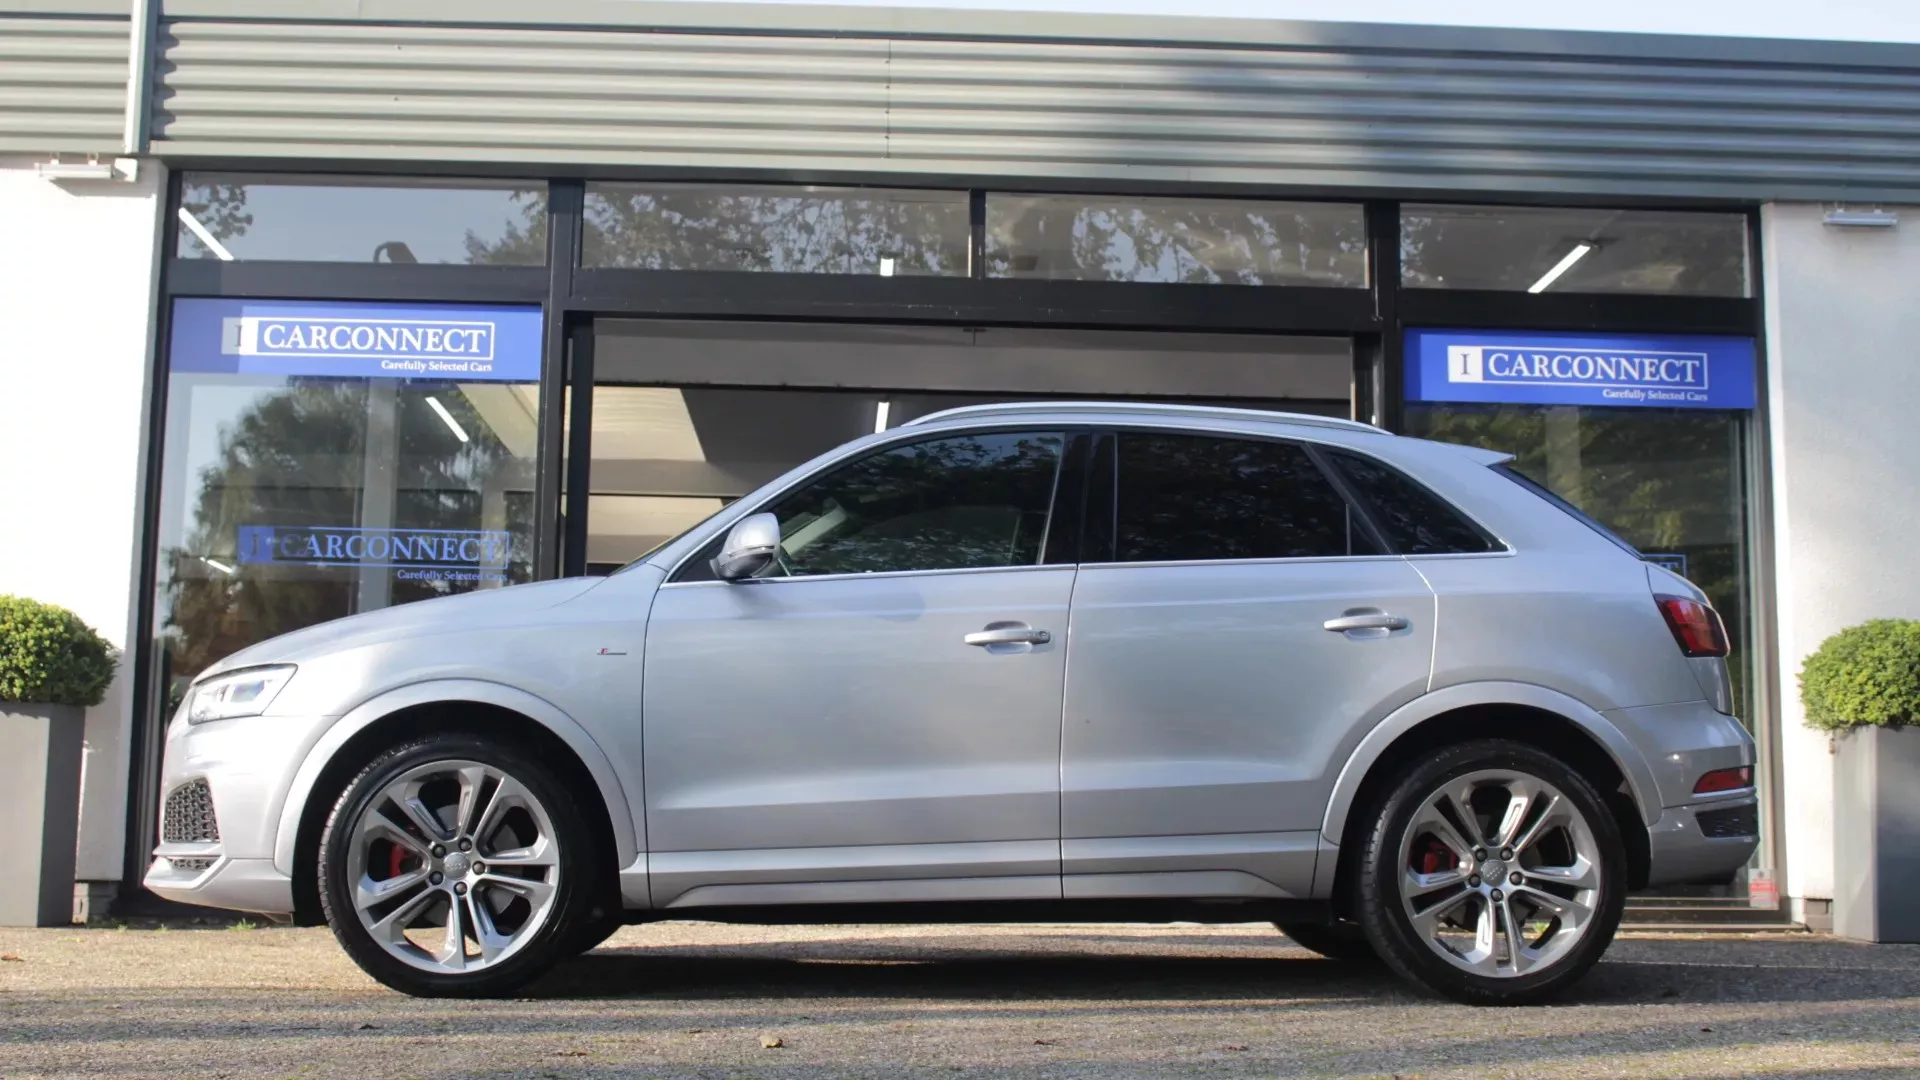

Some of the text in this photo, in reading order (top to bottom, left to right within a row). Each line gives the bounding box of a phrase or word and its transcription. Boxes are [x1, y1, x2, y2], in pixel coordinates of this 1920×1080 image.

[263, 323, 487, 353] CARCONNECT
[381, 359, 493, 374] Carefully Selected Cars
[1460, 352, 1700, 383] I CARCONNECT
[1602, 388, 1708, 402] Carefully Selected Cars
[280, 533, 502, 563] CARCONNECT
[397, 568, 442, 582] Carefully
[444, 570, 483, 581] Selected
